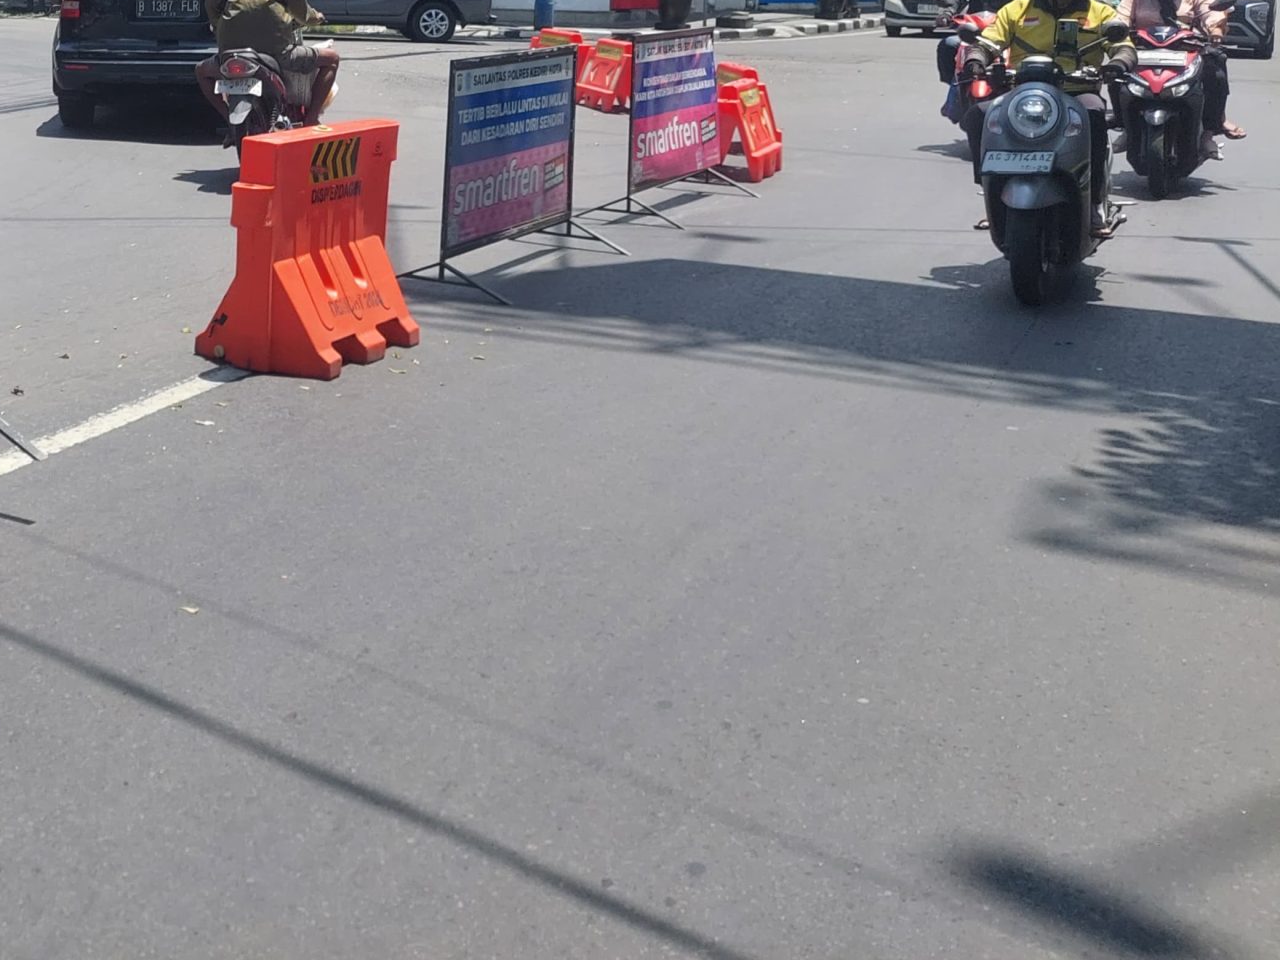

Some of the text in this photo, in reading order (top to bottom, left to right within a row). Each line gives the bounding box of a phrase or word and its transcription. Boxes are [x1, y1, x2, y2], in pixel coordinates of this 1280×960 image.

[138, 0, 145, 12] B
[181, 0, 199, 12] FLR
[473, 71, 507, 86] SATLANTAS
[636, 115, 700, 159] smartfren
[453, 158, 540, 217] smartfren
